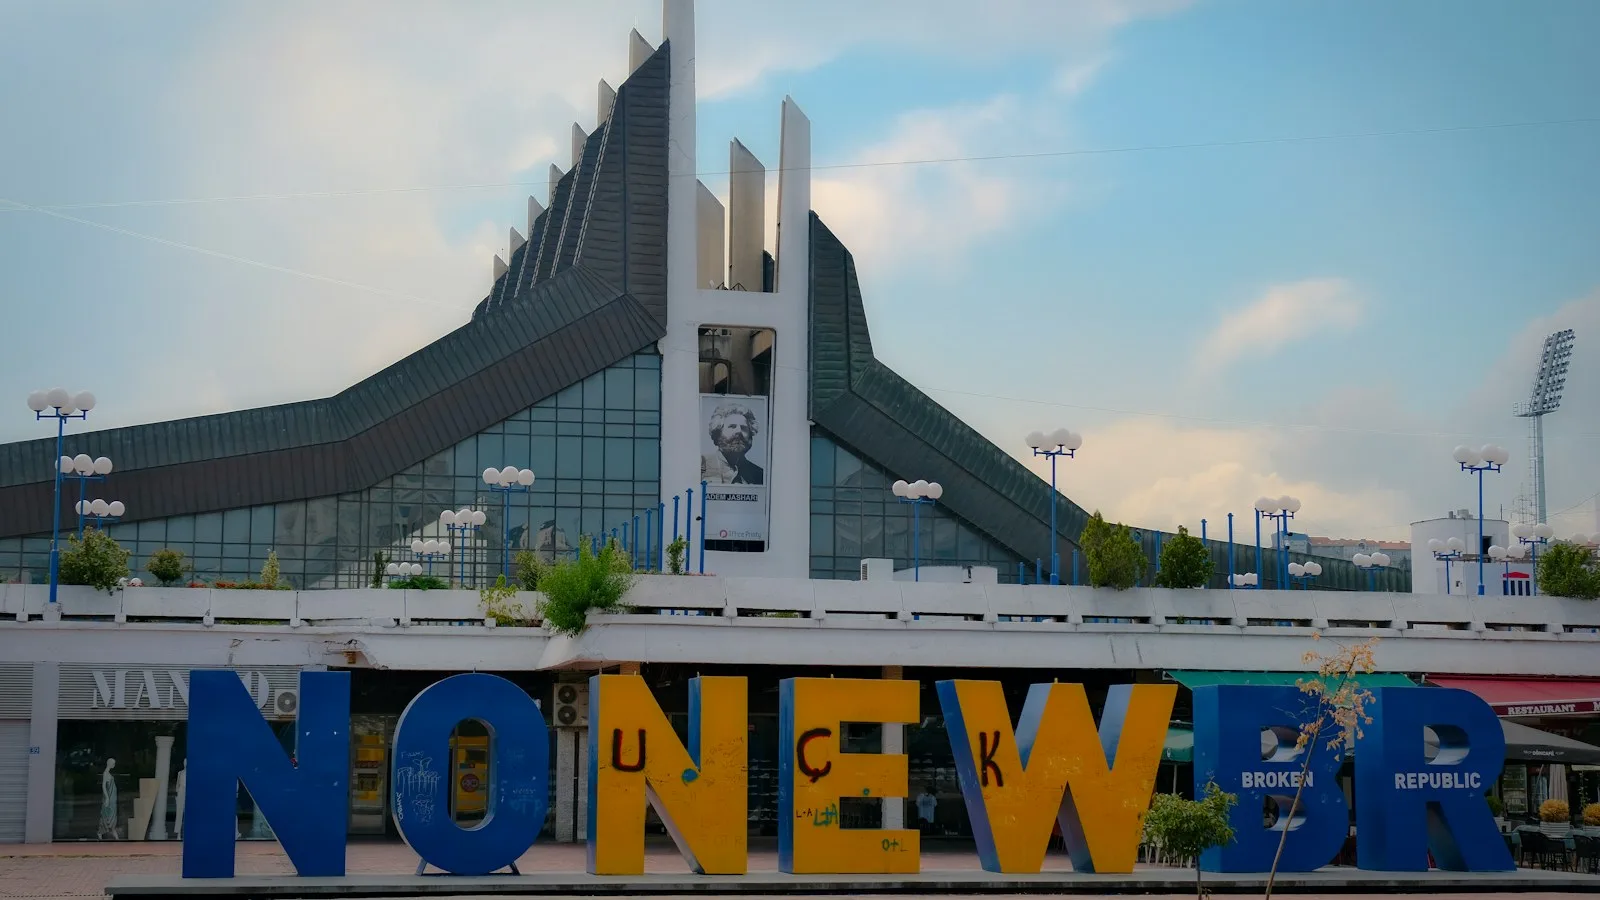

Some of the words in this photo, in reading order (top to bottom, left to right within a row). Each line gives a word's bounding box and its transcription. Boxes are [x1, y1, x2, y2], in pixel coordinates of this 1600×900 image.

[727, 494, 758, 502] JASHARI
[90, 670, 270, 710] MANO
[1507, 704, 1576, 715] RESTAURANT
[612, 728, 646, 772] U
[978, 730, 1004, 787] K
[1241, 771, 1313, 788] BROKEN
[1394, 772, 1481, 789] REPUBLIC
